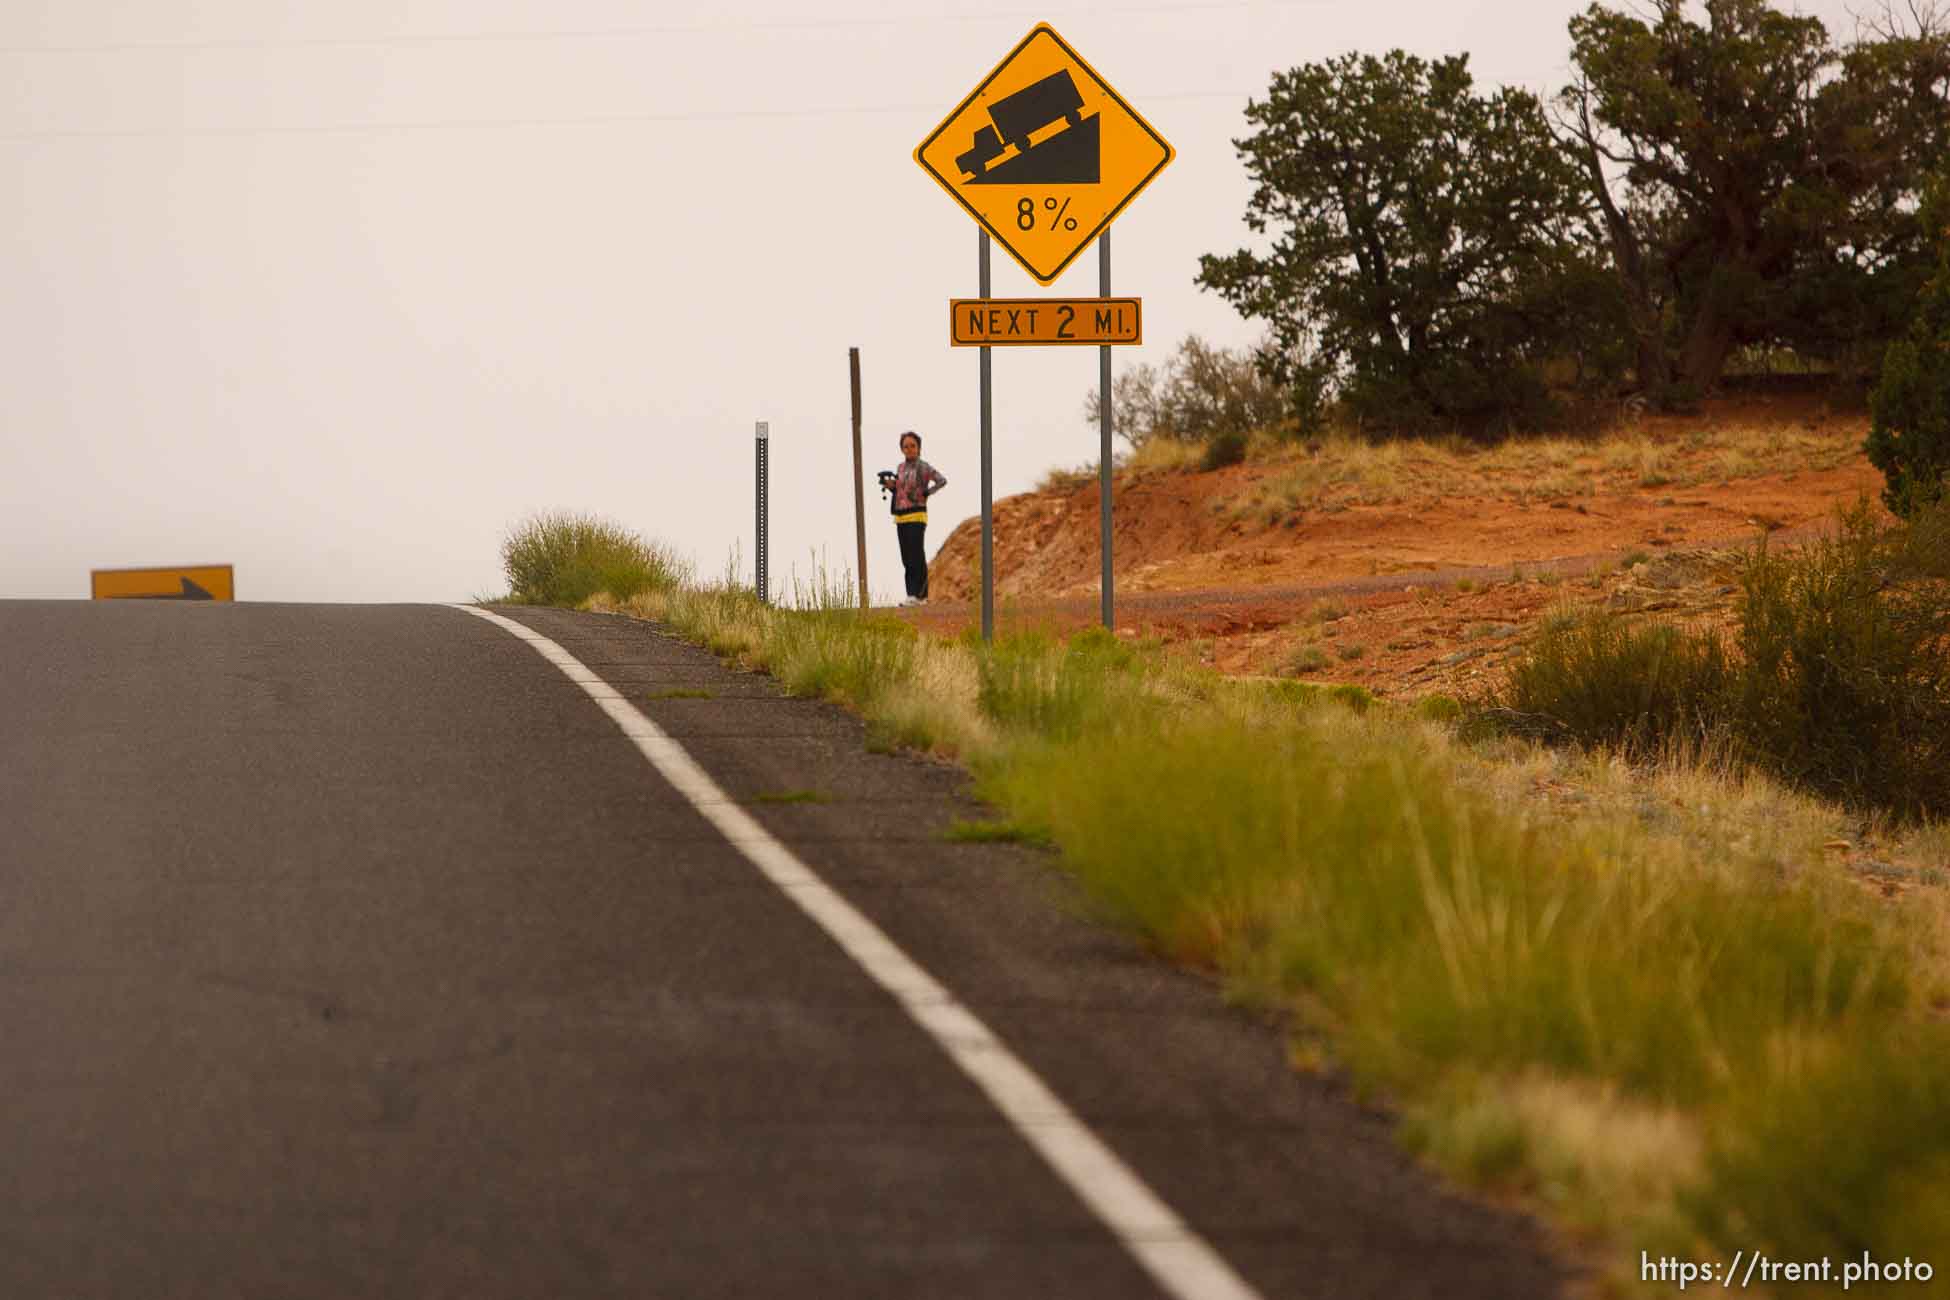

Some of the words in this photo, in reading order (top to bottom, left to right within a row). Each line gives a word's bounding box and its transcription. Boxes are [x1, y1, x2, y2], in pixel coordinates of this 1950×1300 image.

[1017, 197, 1077, 231] 8%
[969, 309, 1038, 335] NEXT
[1056, 305, 1075, 338] 2
[1095, 308, 1131, 334] MI.
